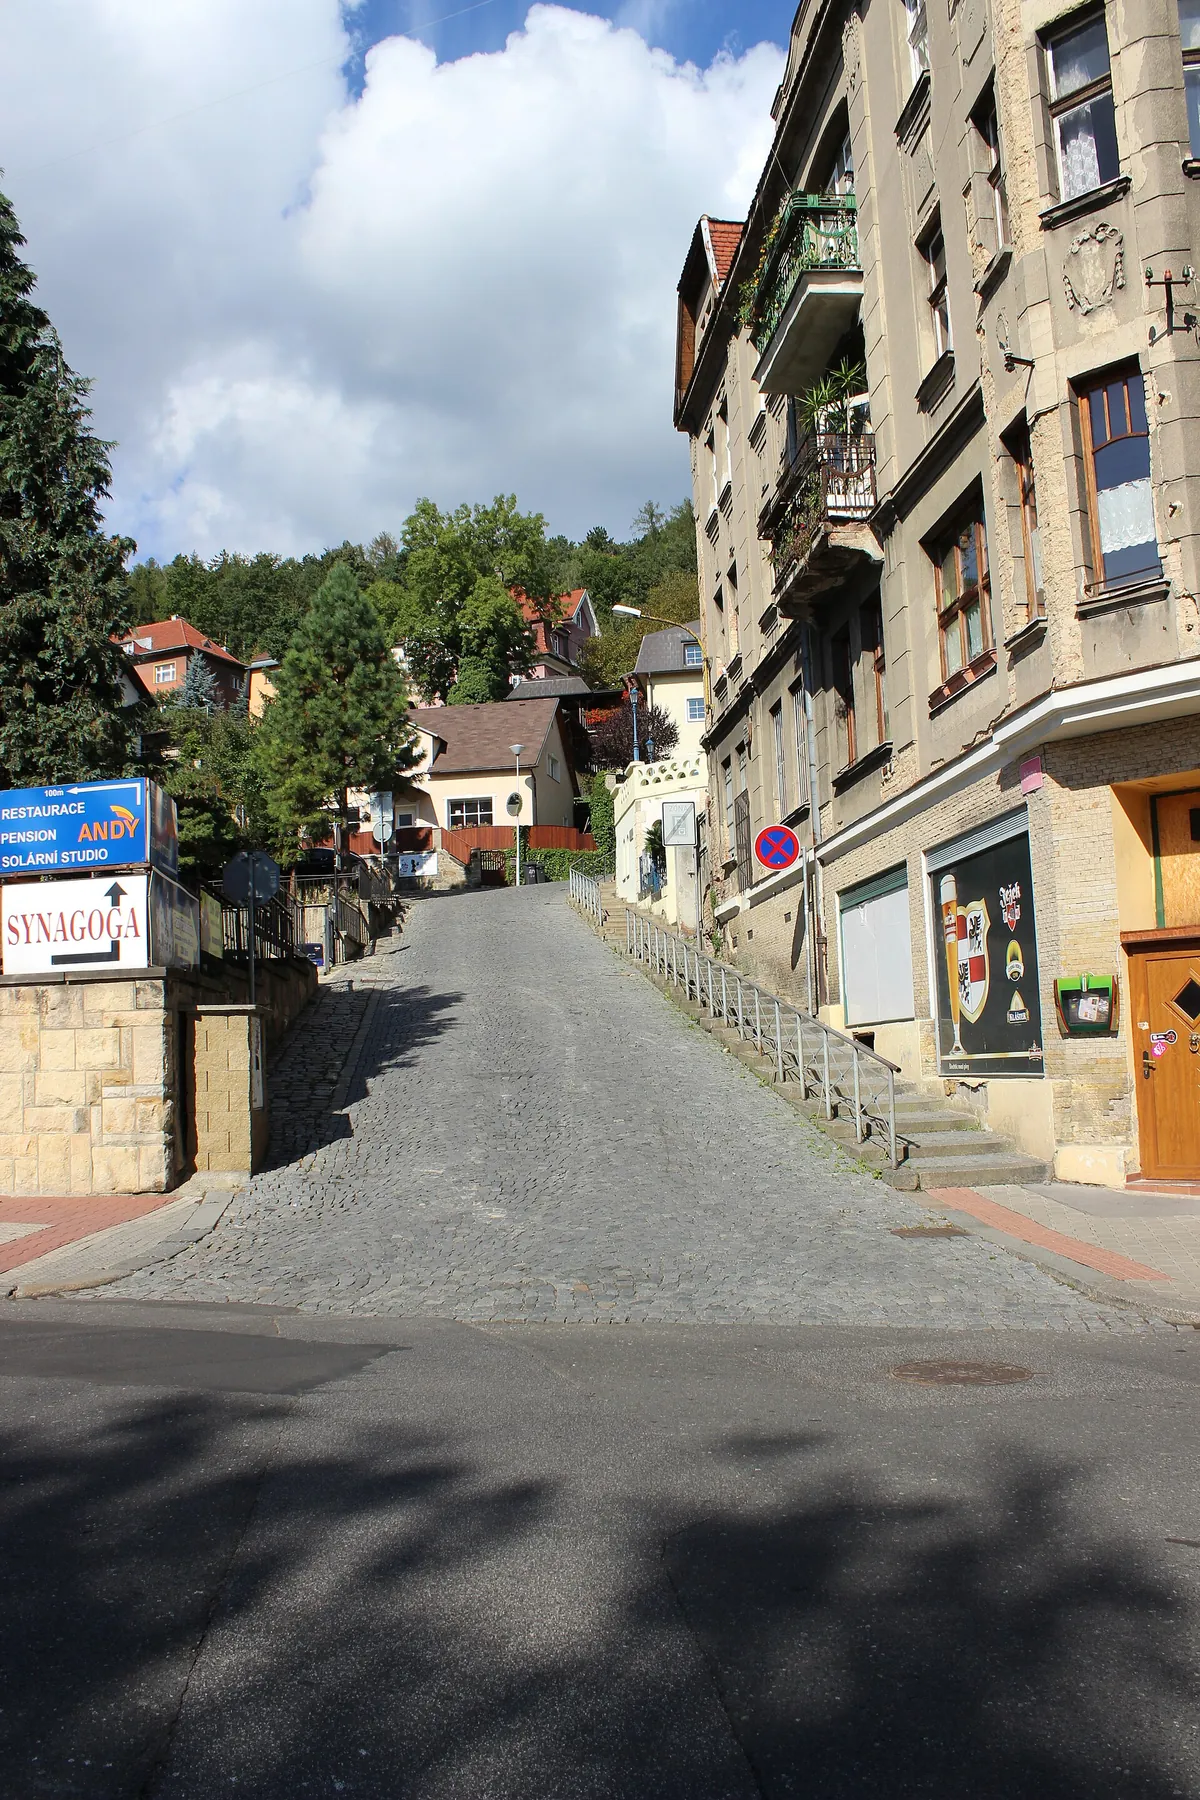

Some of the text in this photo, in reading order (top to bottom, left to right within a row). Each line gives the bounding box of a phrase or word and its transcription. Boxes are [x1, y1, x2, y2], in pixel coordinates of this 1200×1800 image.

[44, 788, 64, 797] 100m
[1, 802, 86, 820] RESTAURACE
[0, 829, 57, 845] PENSION
[78, 818, 140, 843] ANDY
[1, 848, 109, 868] SOLÁRNÍ STUDIO
[7, 907, 141, 946] SYNAGOGA
